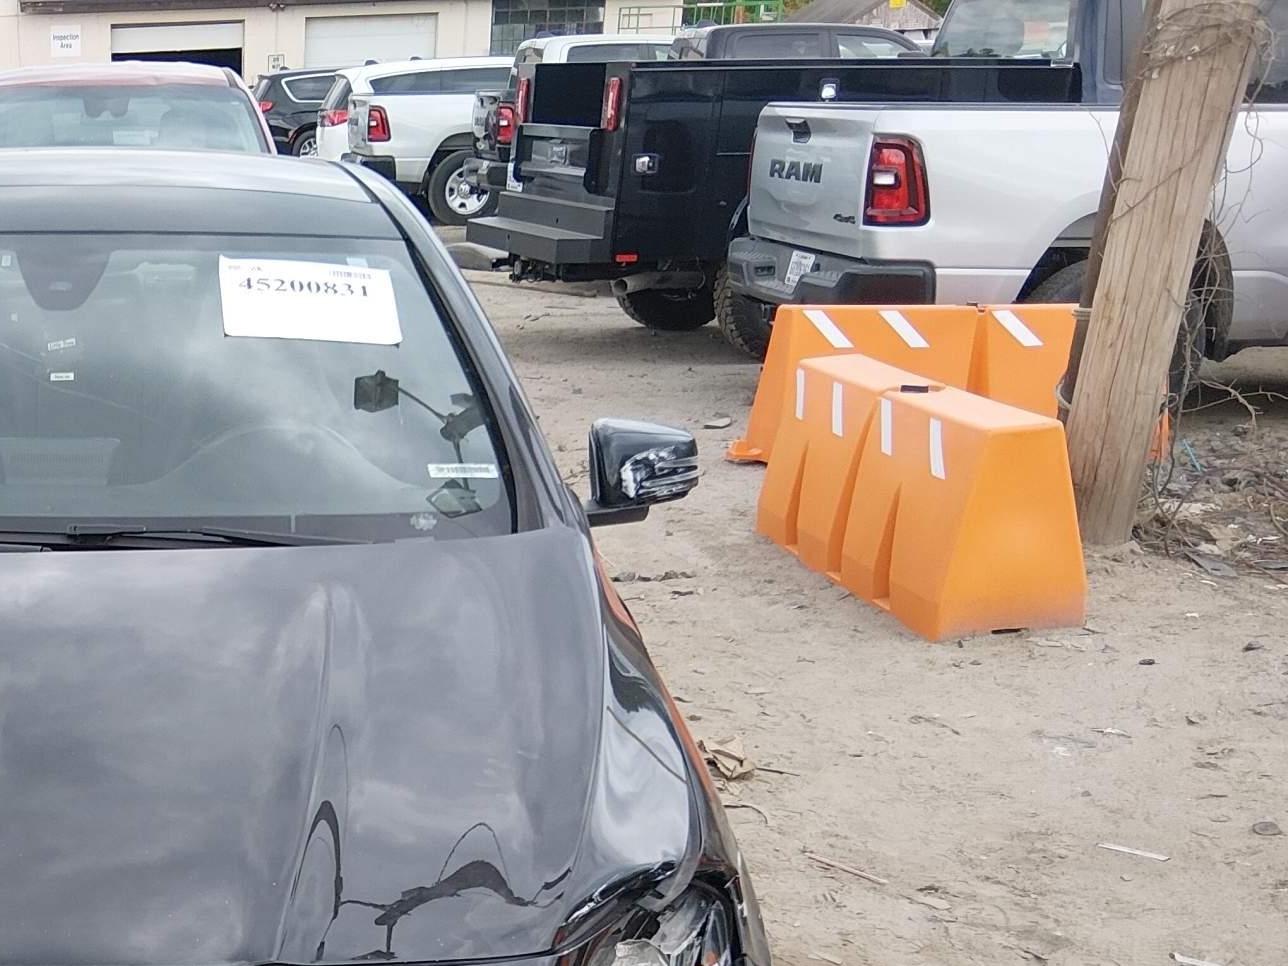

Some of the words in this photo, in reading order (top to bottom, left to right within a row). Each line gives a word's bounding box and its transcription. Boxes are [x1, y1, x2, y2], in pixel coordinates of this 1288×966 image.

[52, 33, 79, 41] Inspection
[769, 159, 823, 184] RAM
[239, 277, 368, 297] 45200831
